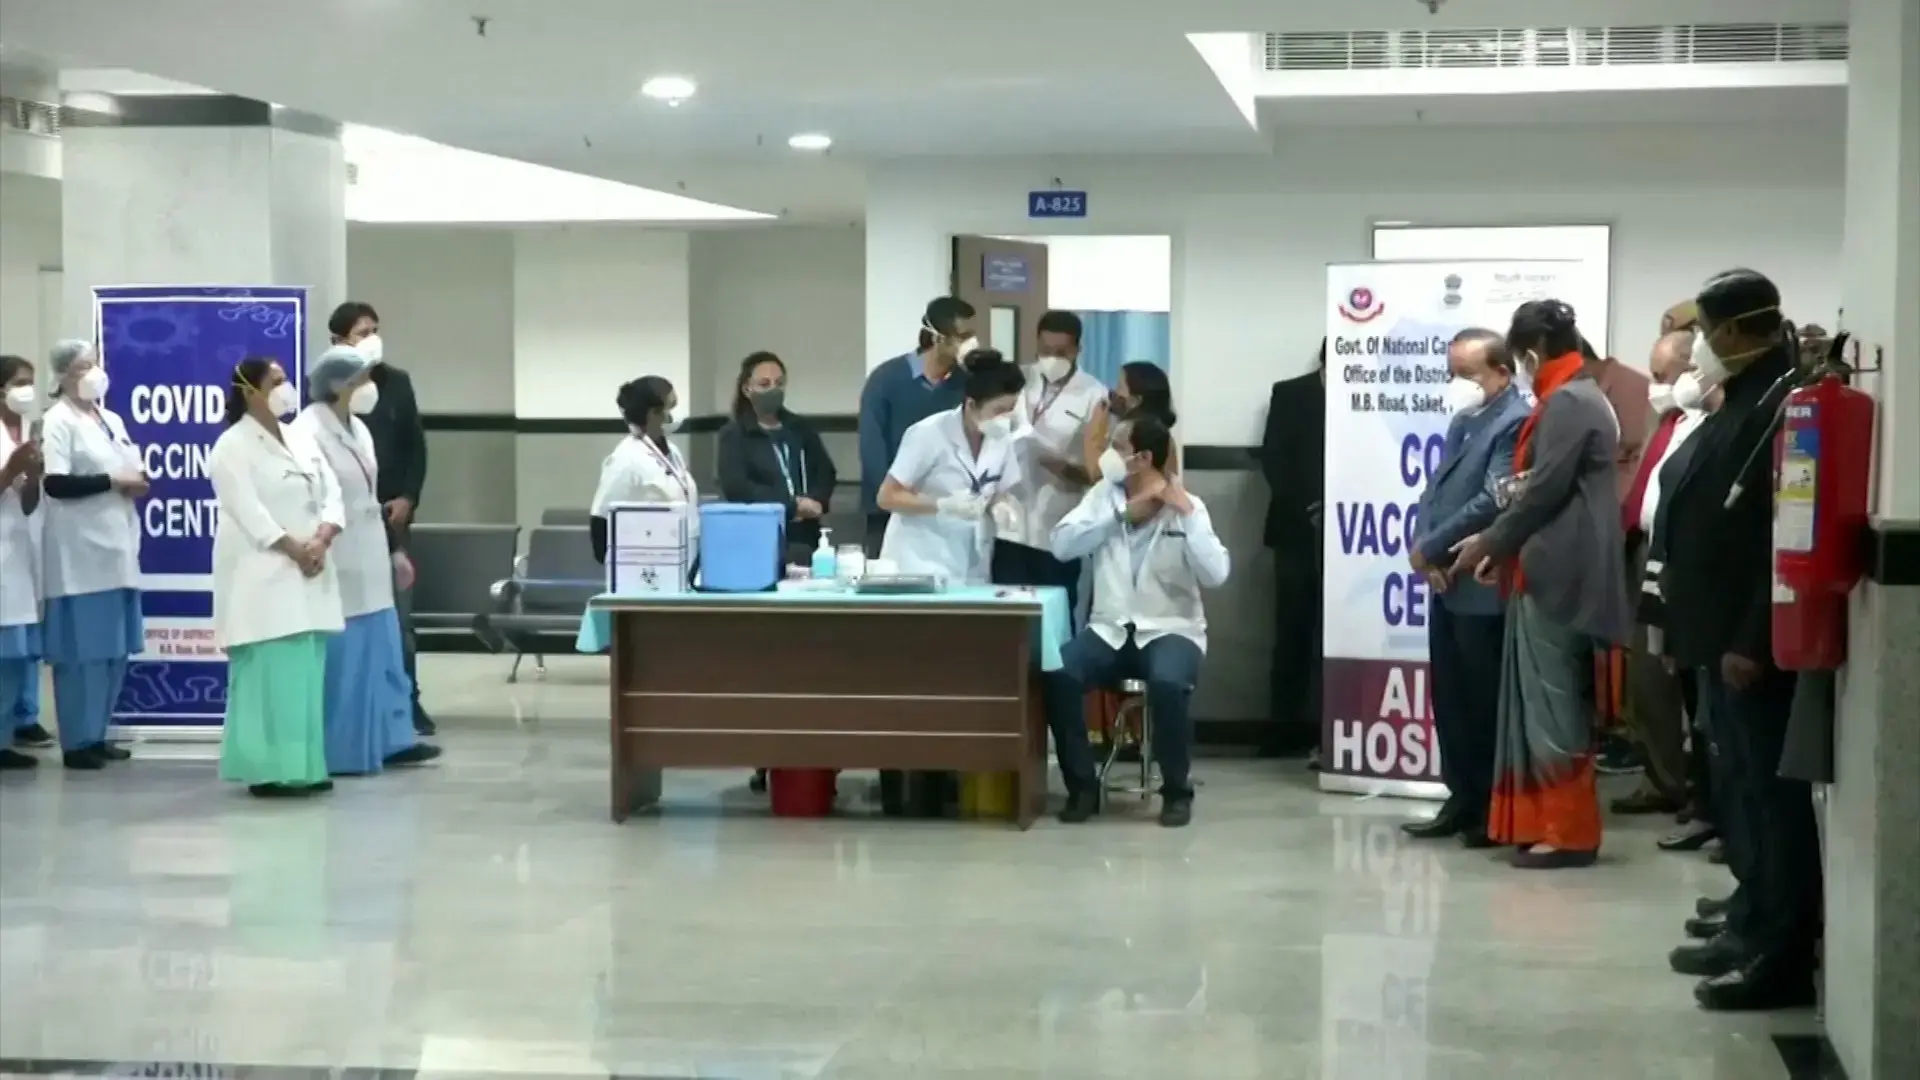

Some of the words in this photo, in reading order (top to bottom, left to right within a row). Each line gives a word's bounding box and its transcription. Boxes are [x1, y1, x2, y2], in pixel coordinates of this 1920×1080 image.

[1035, 196, 1080, 212] A-825
[1335, 336, 1363, 355] Govt.
[1366, 336, 1379, 355] Of
[1382, 336, 1429, 355] National
[1432, 336, 1451, 355] Ca
[1343, 364, 1376, 383] Office
[1379, 364, 1391, 383] of
[1393, 364, 1412, 383] the
[131, 384, 226, 424] COVID
[1351, 393, 1375, 412] M.B.
[1378, 393, 1408, 414] Road,
[1412, 393, 1446, 414] Saket,
[1379, 667, 1435, 719] AI
